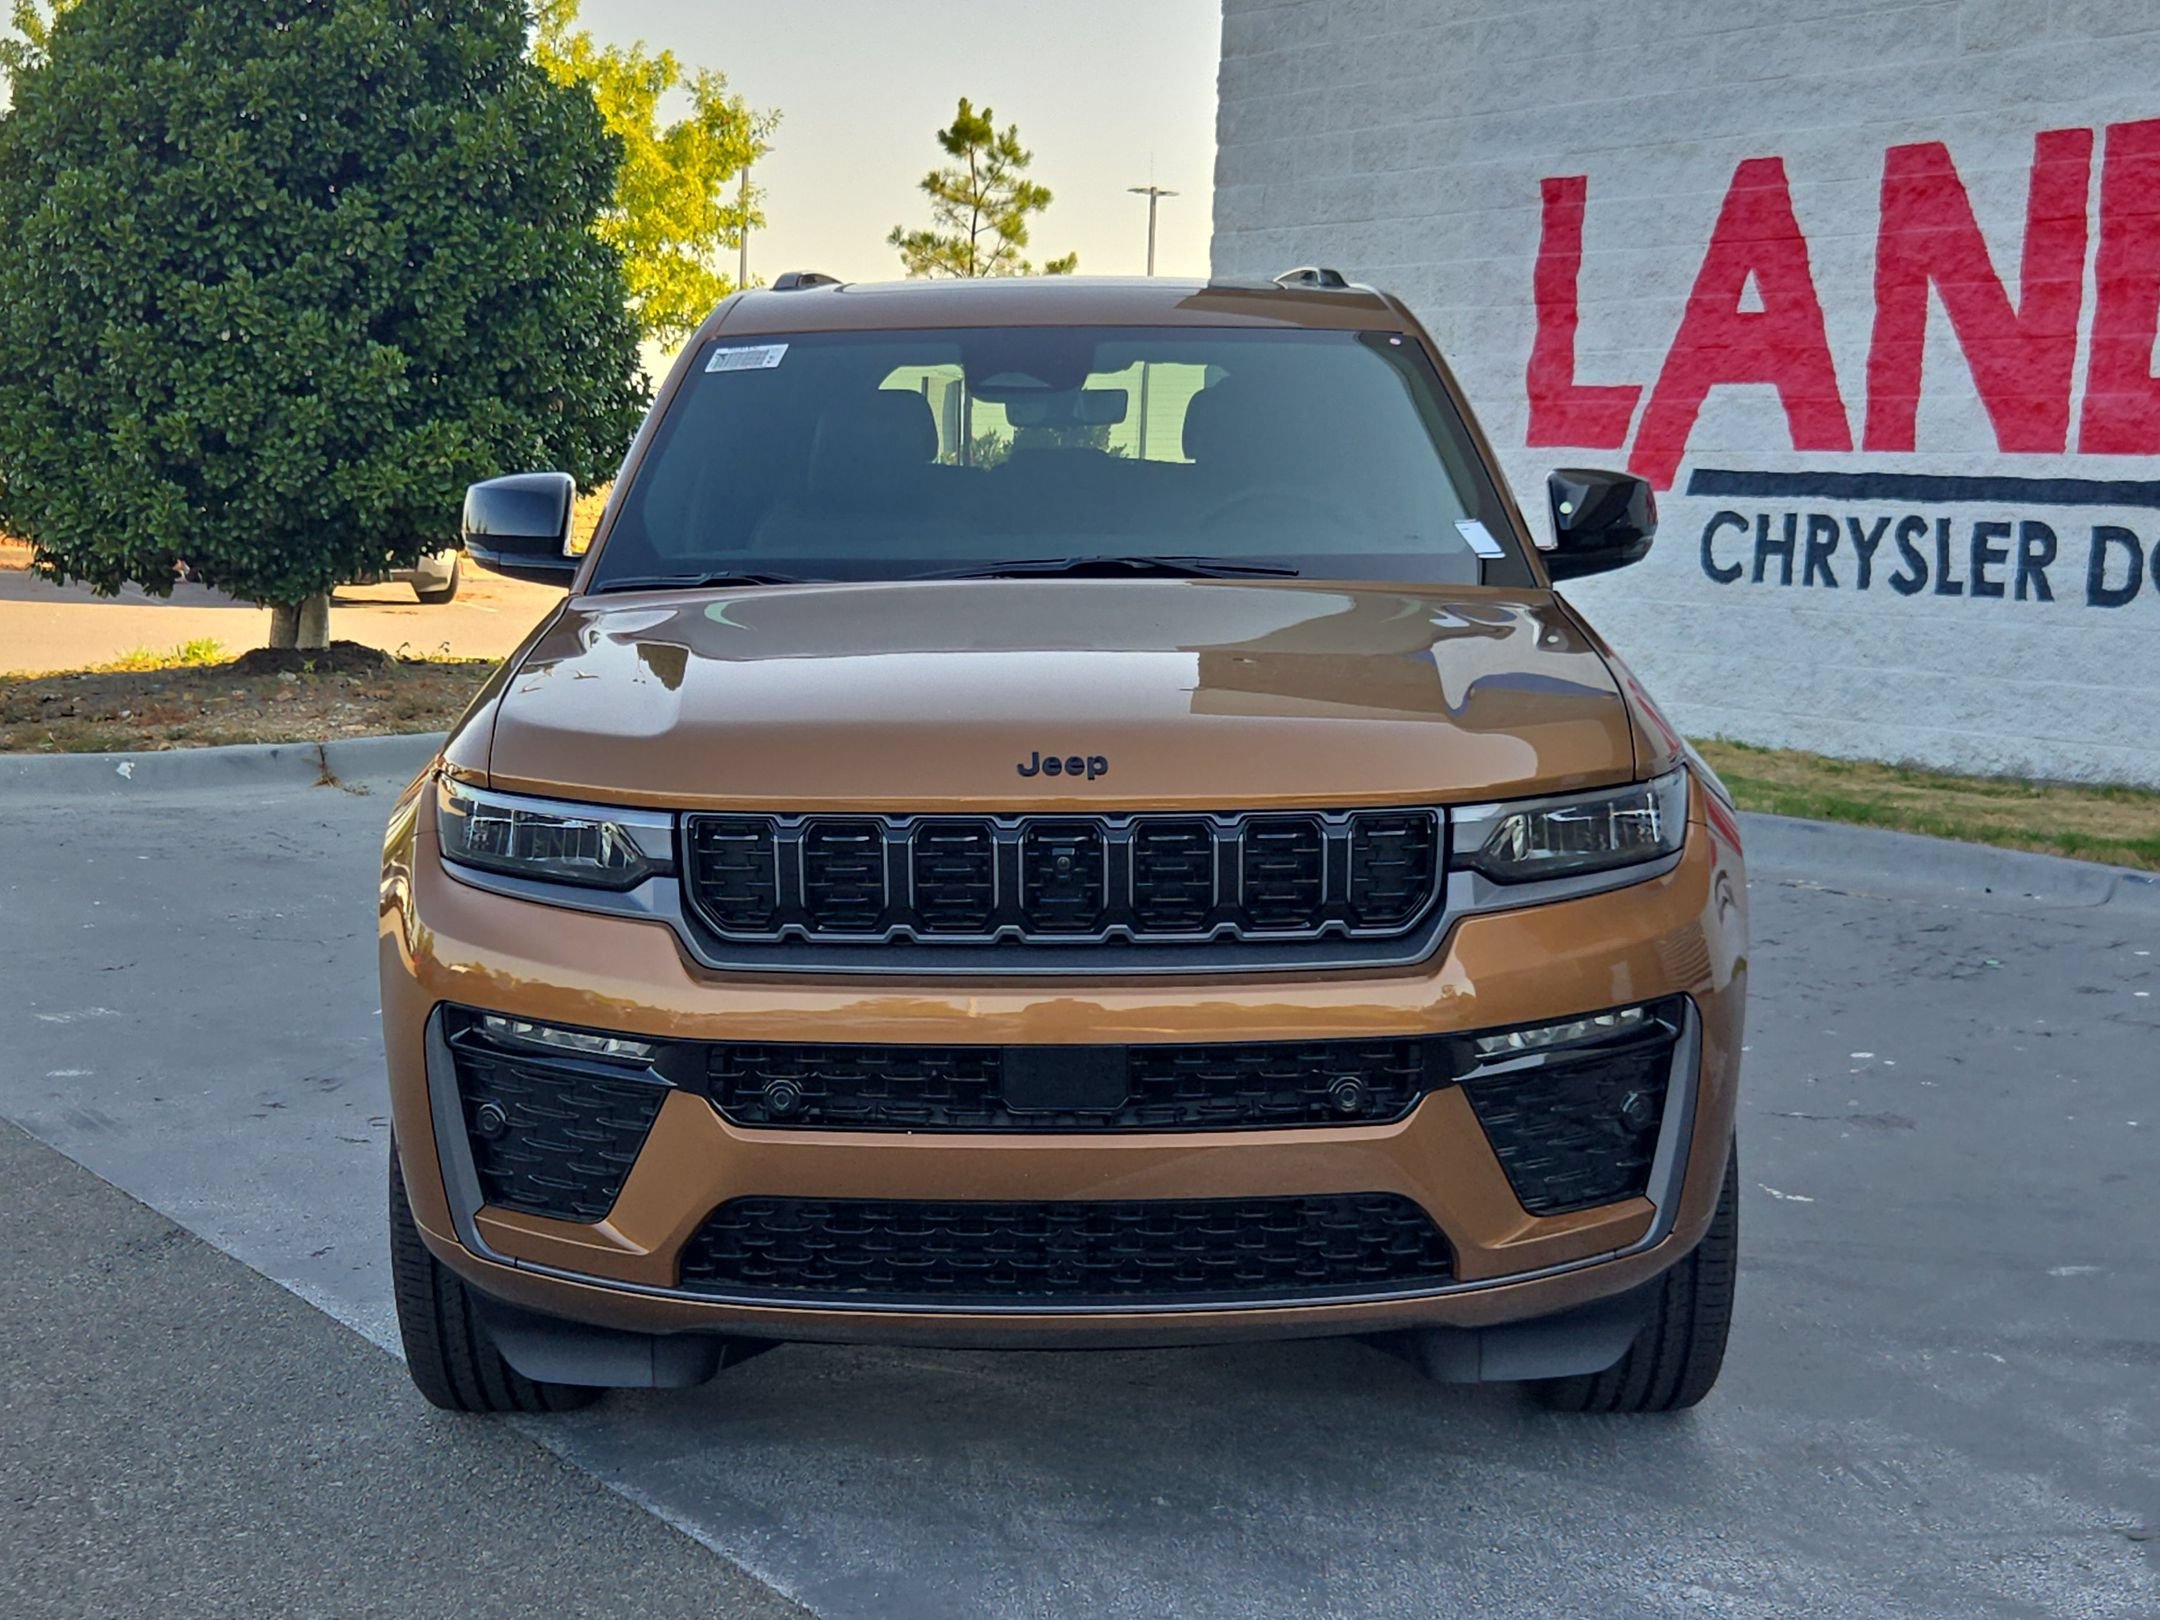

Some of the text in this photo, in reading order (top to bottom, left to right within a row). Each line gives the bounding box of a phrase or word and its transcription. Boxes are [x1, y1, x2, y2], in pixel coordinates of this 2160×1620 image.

[1700, 510, 2160, 608] CHRYSLER D
[1017, 751, 1108, 780] Jeep
